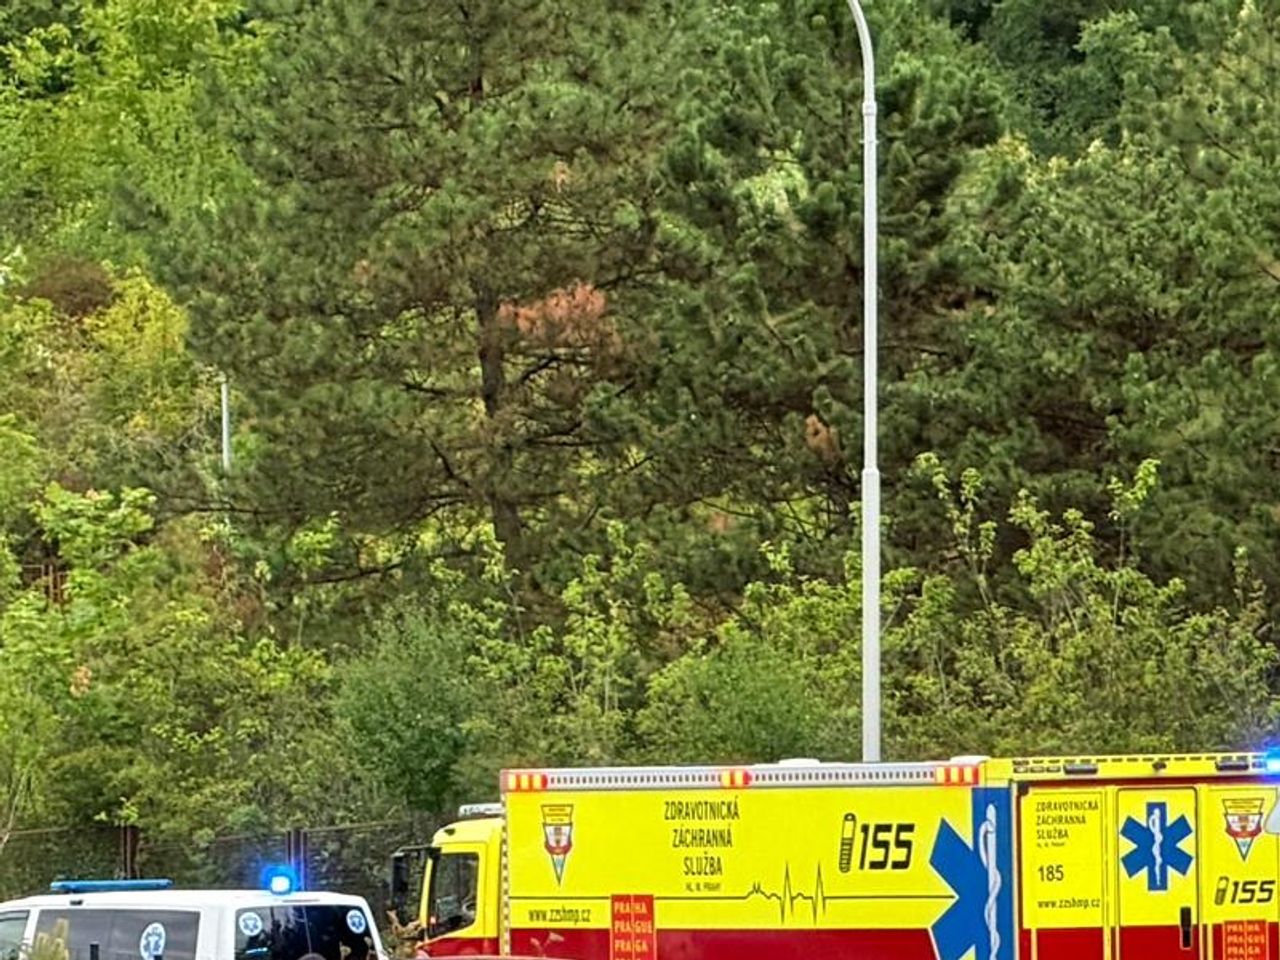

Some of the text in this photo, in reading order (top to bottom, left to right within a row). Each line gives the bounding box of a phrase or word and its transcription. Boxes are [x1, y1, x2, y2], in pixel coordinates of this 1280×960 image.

[664, 795, 740, 820] ZDRAVOTNICKÁ
[672, 823, 733, 848] ZÁCHRANNÁ
[859, 823, 915, 871] 155
[683, 850, 722, 876] SLUŽBA
[1038, 864, 1065, 882] 185
[1231, 880, 1276, 903] 155
